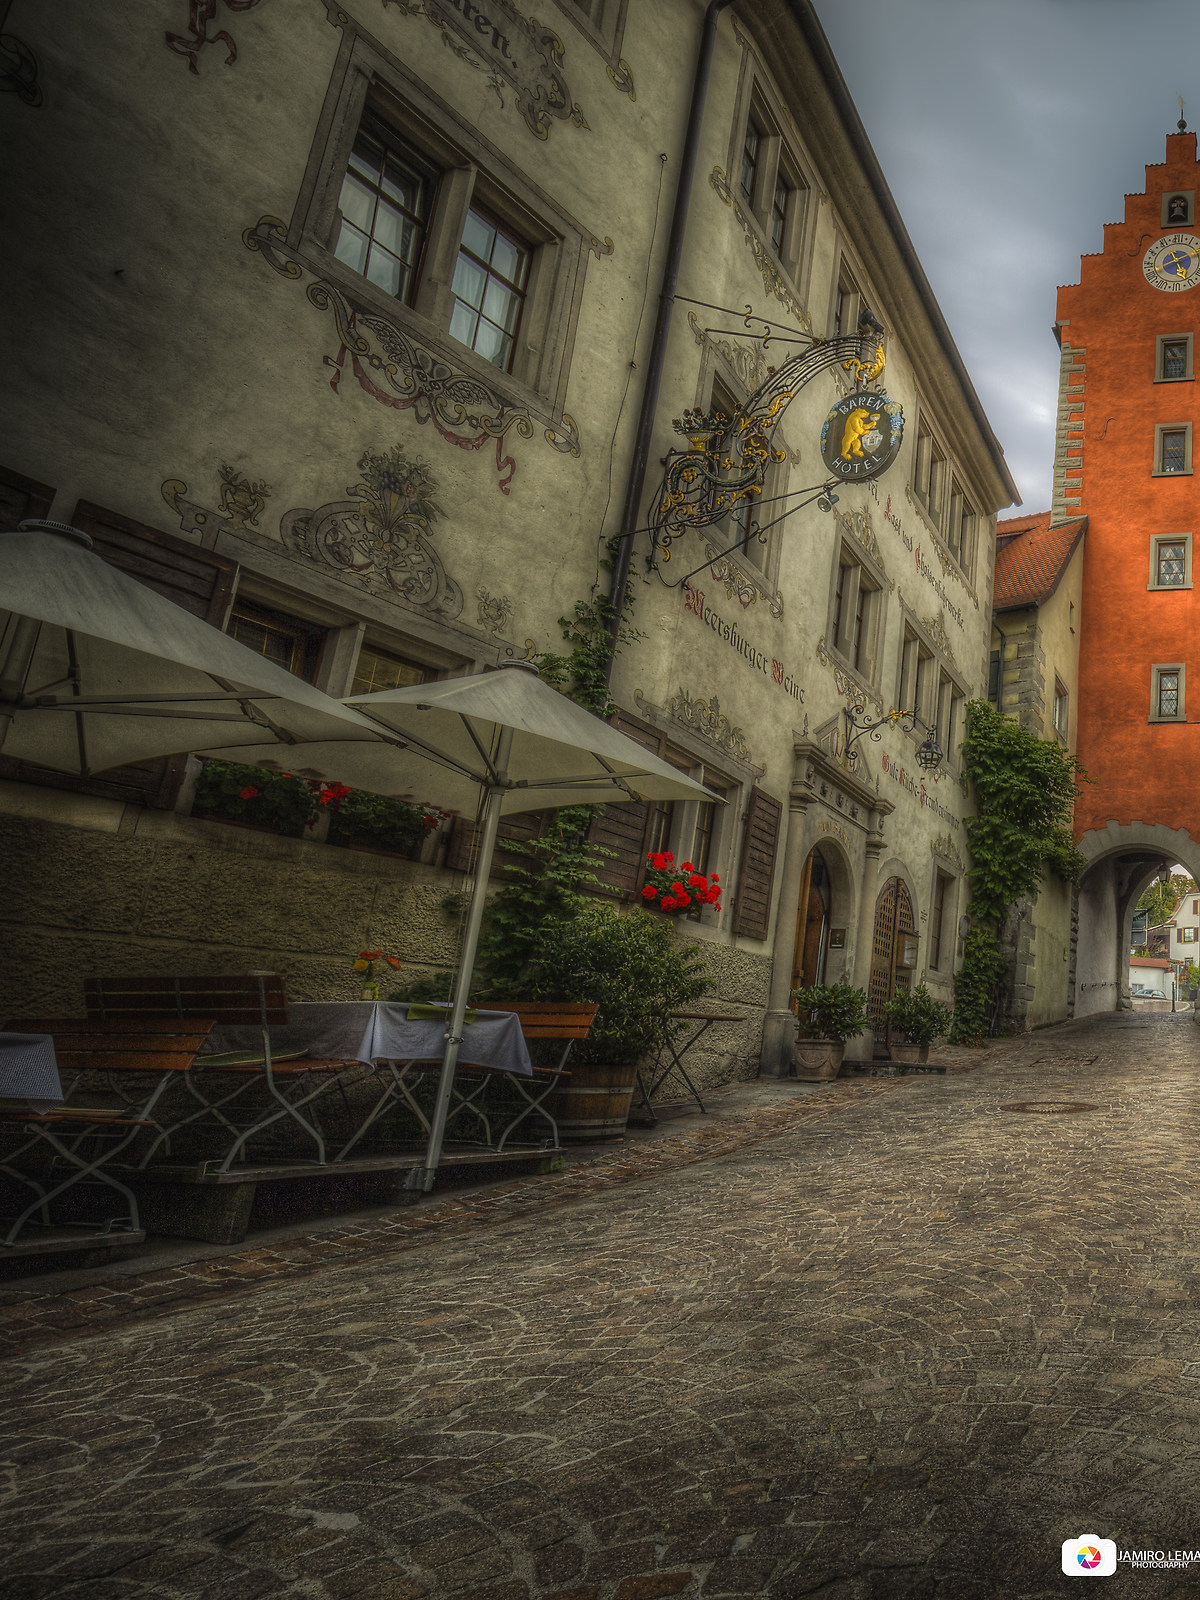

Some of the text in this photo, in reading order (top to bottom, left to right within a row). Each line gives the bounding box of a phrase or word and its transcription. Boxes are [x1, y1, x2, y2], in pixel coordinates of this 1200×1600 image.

[832, 455, 881, 473] HOTEL
[685, 581, 805, 704] Meersburger Weine
